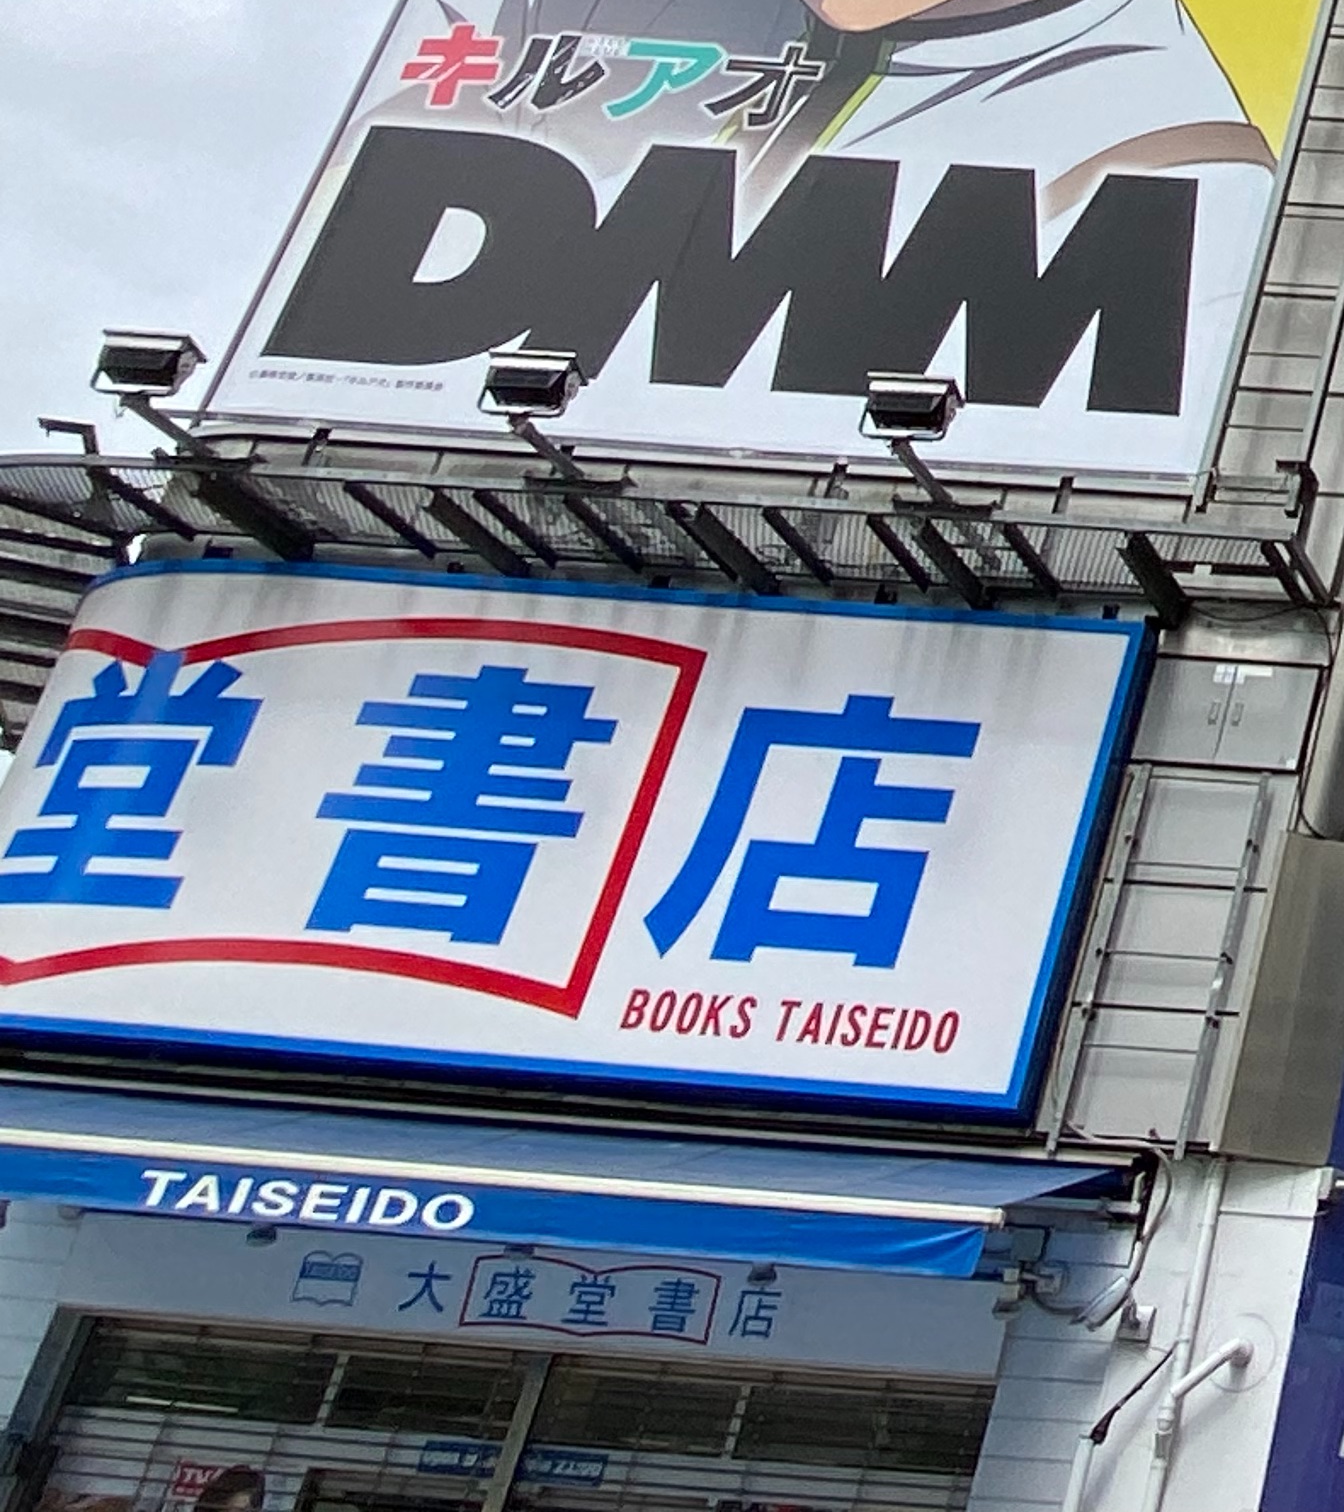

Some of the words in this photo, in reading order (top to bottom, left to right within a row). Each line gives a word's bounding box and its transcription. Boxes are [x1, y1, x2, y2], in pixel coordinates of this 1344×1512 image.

[400, 22, 825, 128] キルアオ
[261, 124, 1199, 417] DMM
[0, 650, 983, 971] 堂書店
[619, 988, 759, 1041] BOOKS
[777, 996, 962, 1056] TAISEIDO
[139, 1167, 476, 1232] TAISEIDO
[399, 1265, 783, 1342] 大盛堂書店
